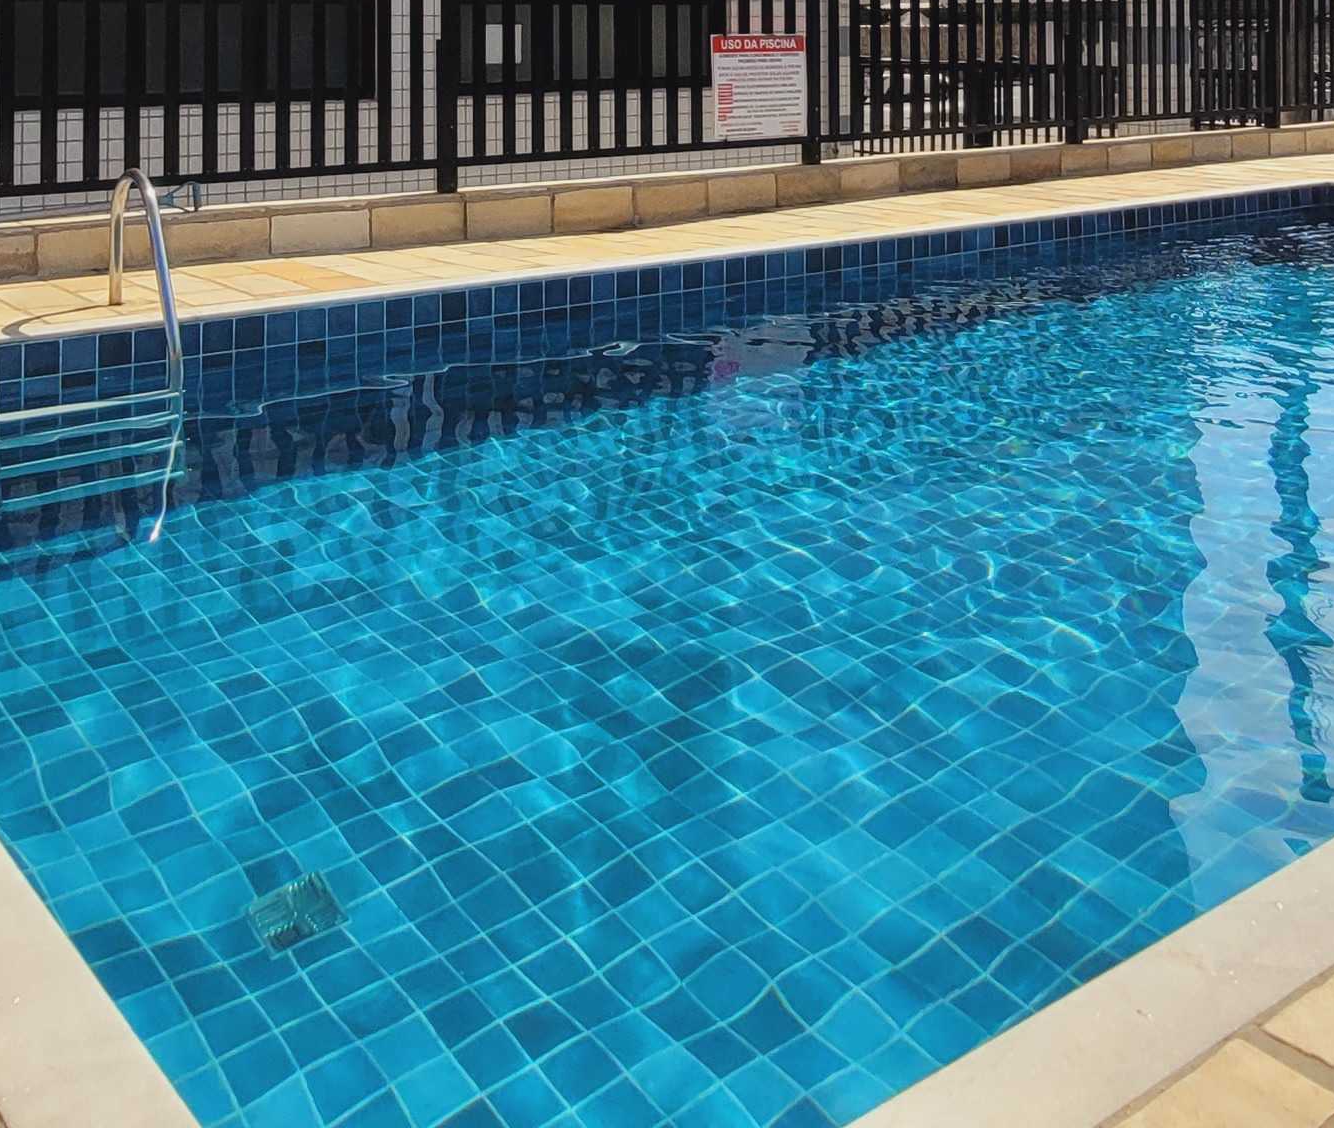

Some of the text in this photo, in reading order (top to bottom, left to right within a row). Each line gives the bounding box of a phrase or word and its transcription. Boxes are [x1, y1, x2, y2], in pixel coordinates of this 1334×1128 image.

[721, 39, 797, 50] USO DA PISCINA
